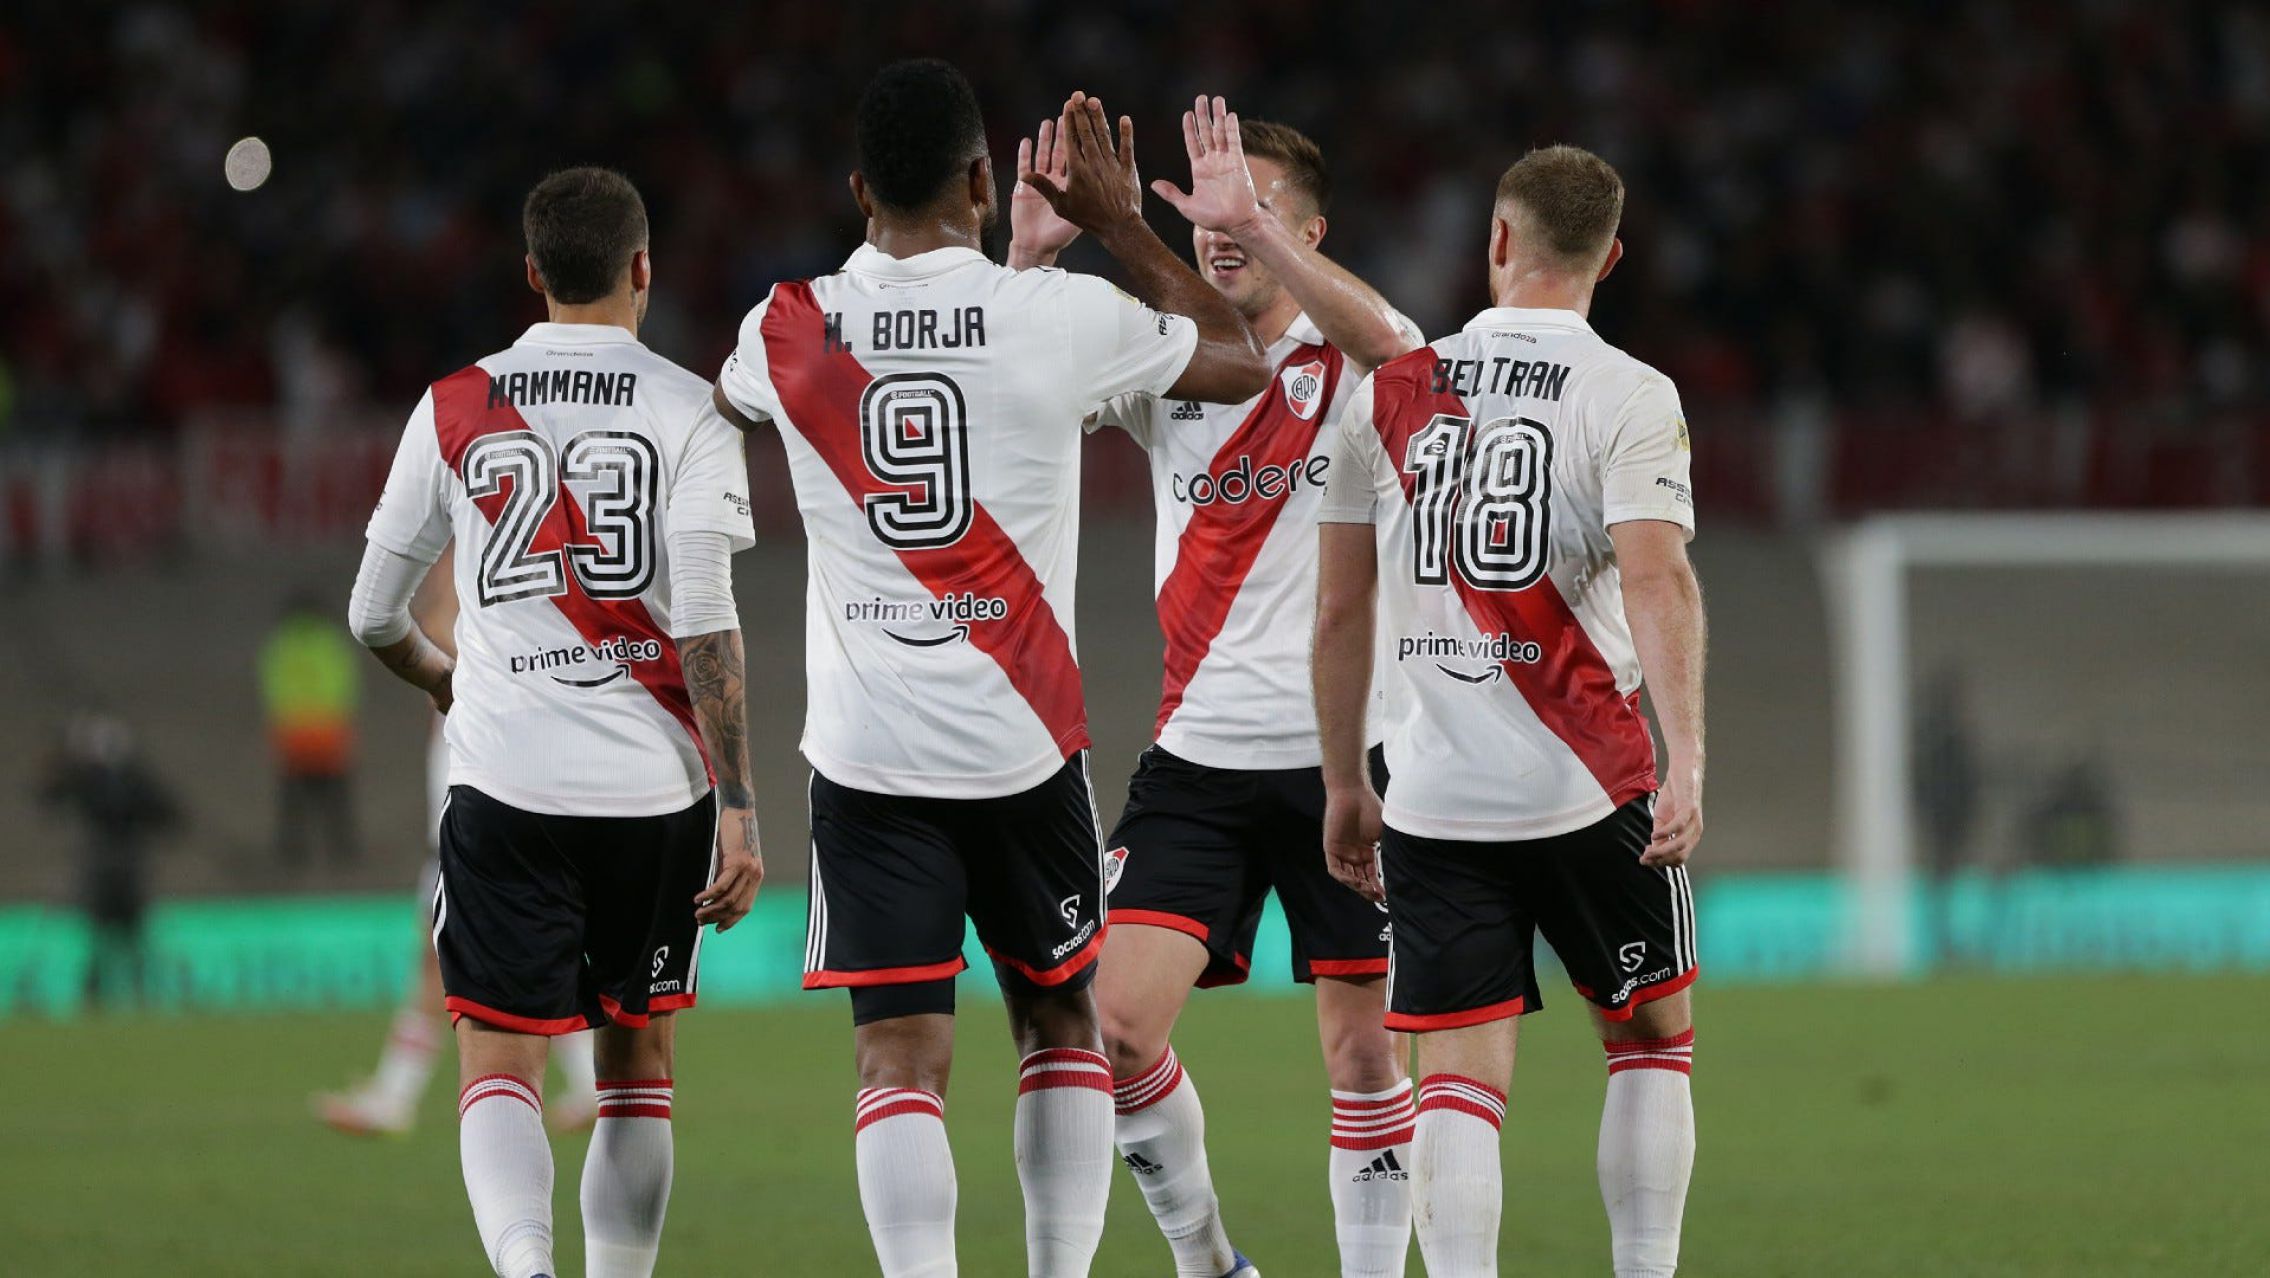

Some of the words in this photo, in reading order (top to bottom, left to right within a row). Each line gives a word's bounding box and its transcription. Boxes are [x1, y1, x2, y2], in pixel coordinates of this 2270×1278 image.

[823, 312, 853, 355] M.
[872, 305, 987, 351] BORJA
[488, 370, 637, 408] MAMMANA
[1429, 356, 1572, 402] BELTRAN
[860, 372, 974, 550] 9
[1172, 455, 1331, 505] codere
[463, 431, 659, 608] 23
[1403, 413, 1555, 592] 18
[845, 596, 924, 622] prime
[928, 592, 1008, 622] video
[510, 646, 586, 675] prime
[589, 636, 661, 662] video
[1467, 632, 1541, 663] video
[1051, 919, 1096, 960] socios.com
[1352, 1169, 1408, 1183] adidas
